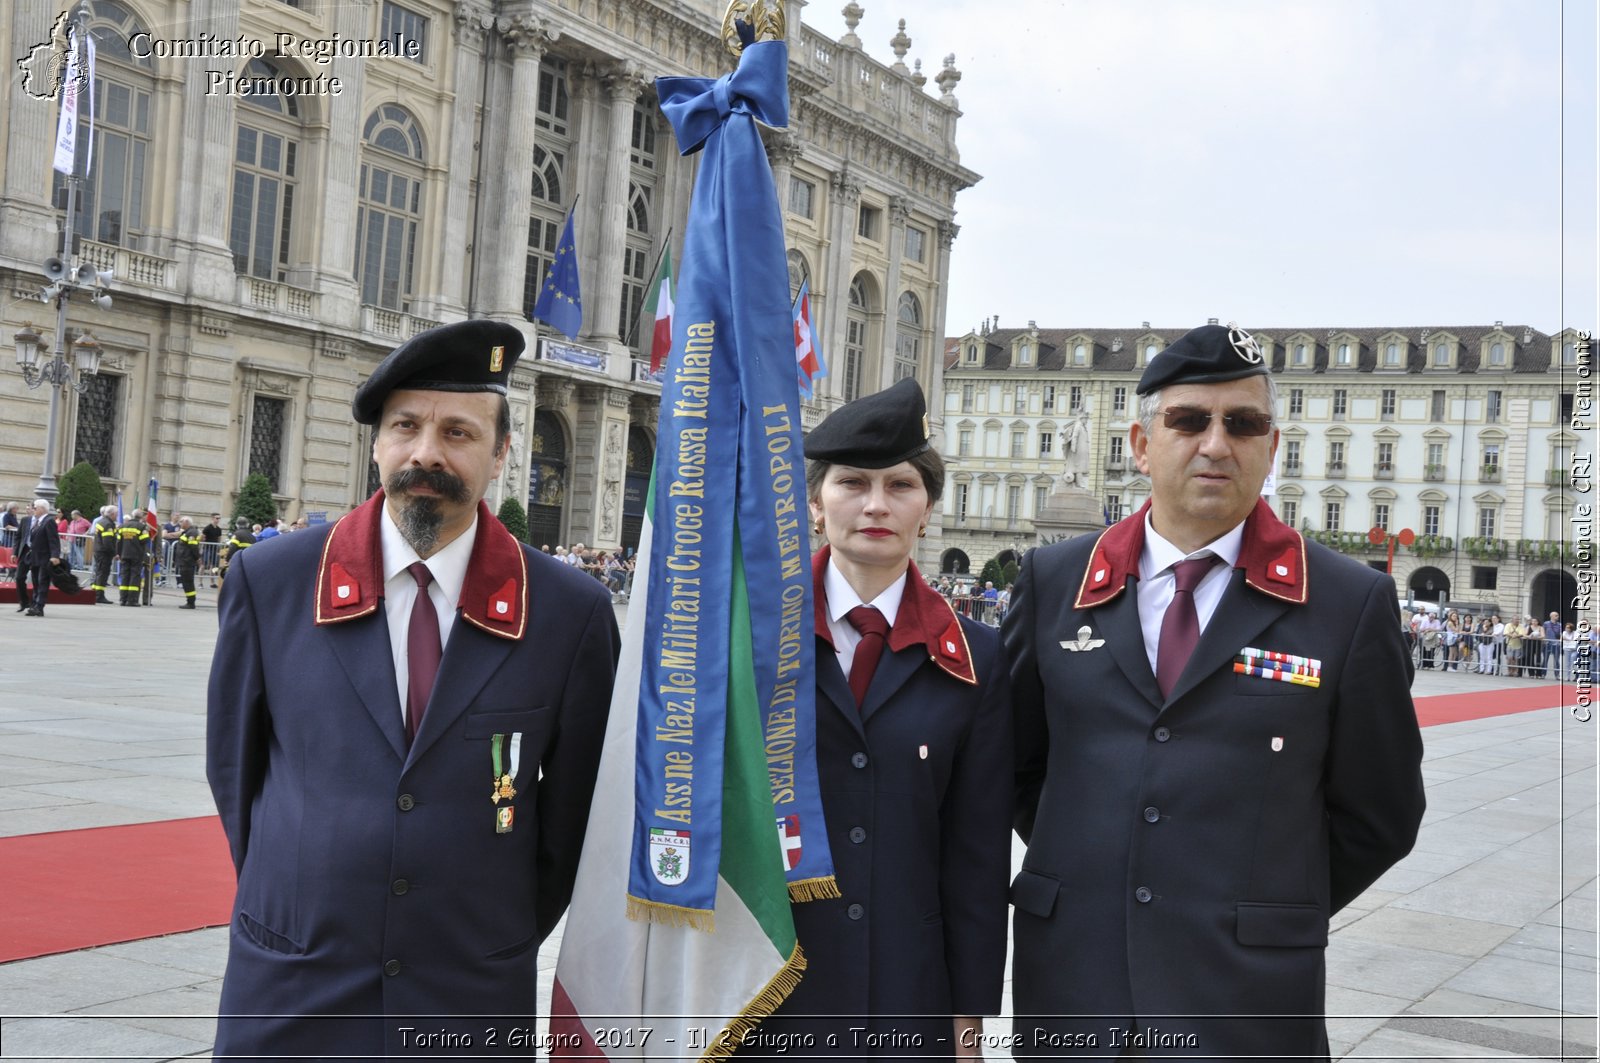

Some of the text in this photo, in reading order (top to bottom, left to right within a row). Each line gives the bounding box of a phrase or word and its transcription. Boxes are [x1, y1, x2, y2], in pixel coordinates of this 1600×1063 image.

[673, 320, 715, 420] Italiana
[669, 427, 709, 498] Rossa
[665, 504, 704, 572] Croce
[661, 577, 701, 671] Militari
[762, 403, 804, 804] SEZIONE DI TORINO METROPOLI
[655, 752, 693, 824] Ass.ne
